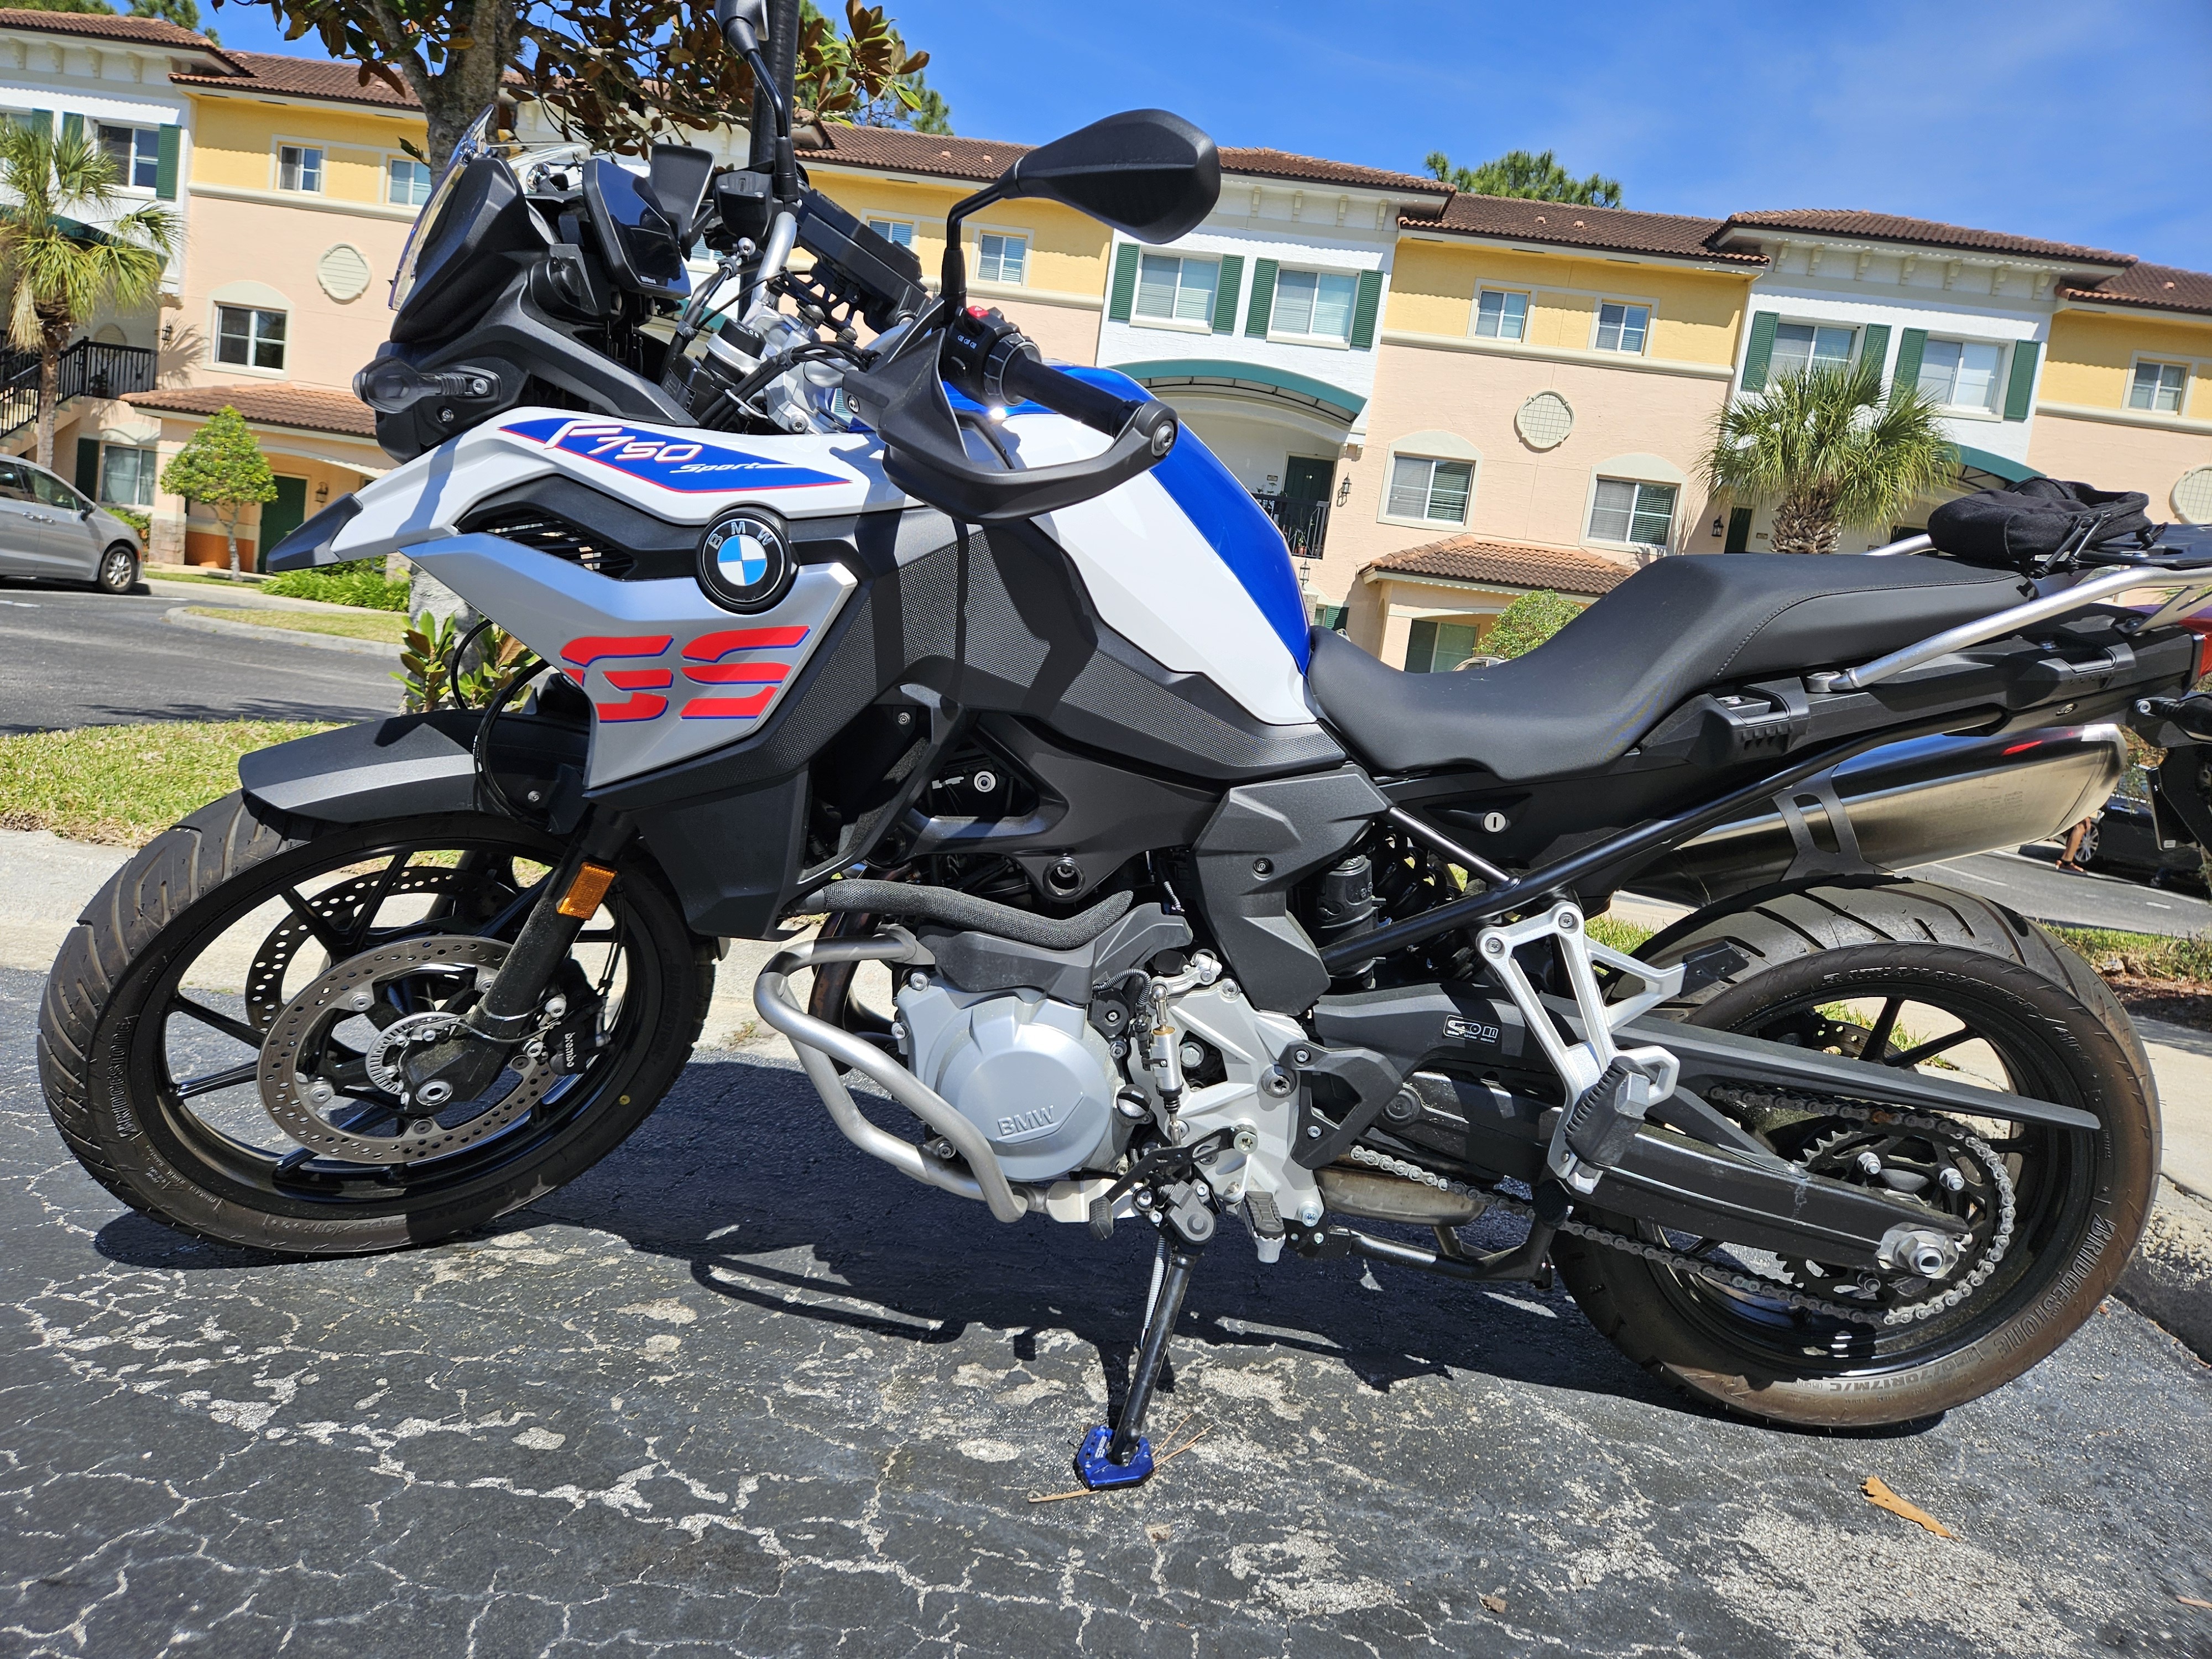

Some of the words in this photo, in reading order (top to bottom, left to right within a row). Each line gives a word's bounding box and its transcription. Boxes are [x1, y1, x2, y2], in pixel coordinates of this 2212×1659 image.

[669, 461, 777, 473] Sport
[708, 521, 773, 550] BMW
[560, 625, 810, 723] GS
[564, 1031, 577, 1068] brembo
[108, 1021, 139, 1139] BRIDGESTONE
[997, 1105, 1054, 1136] BMW
[1993, 1213, 2117, 1357] BRIDGESTONE
